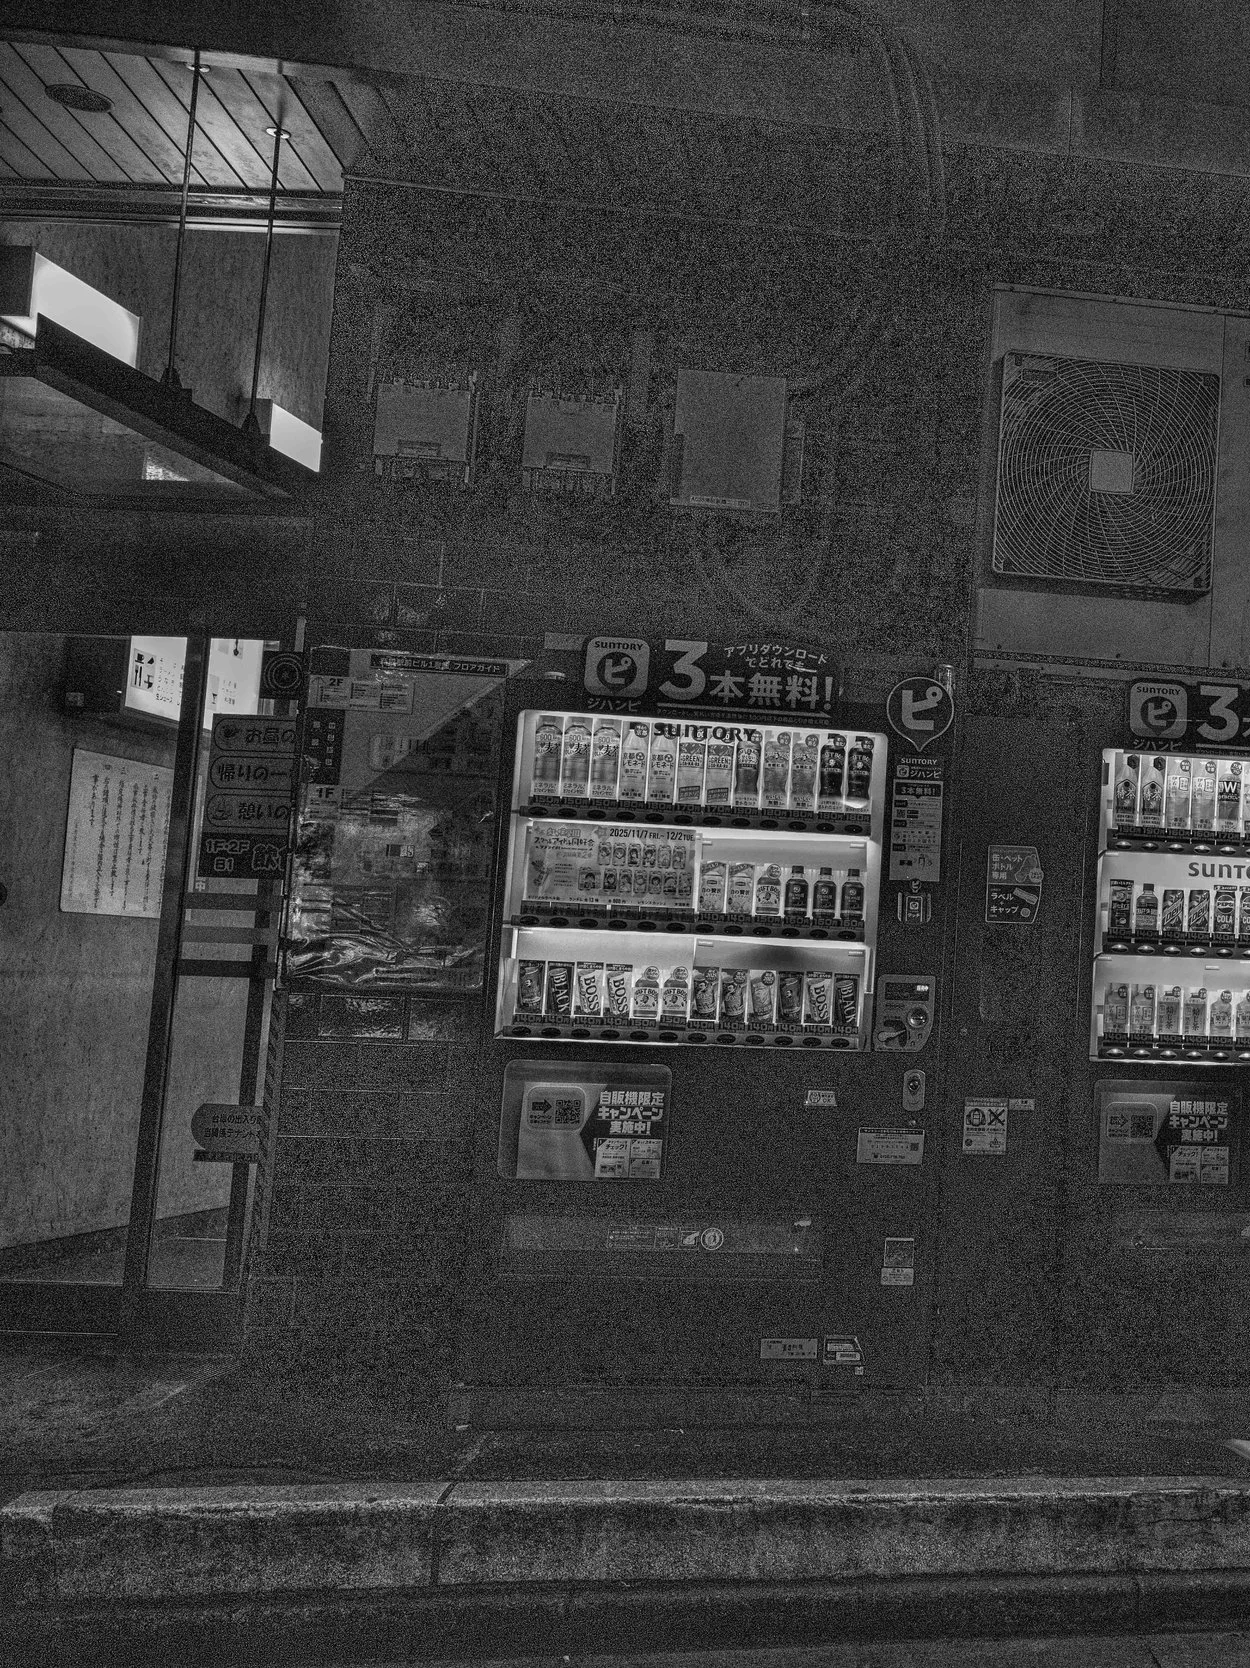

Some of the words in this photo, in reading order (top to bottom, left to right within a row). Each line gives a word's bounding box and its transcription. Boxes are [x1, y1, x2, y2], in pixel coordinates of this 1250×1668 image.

[594, 640, 643, 652] SUNTORY
[329, 678, 344, 687] 2F
[1136, 686, 1181, 696] SUNTORY
[588, 699, 642, 712] ジハンピ
[653, 722, 757, 742] SUNTORY
[1133, 739, 1182, 751] ジハンピ
[901, 758, 938, 766] SUNTORY
[609, 828, 648, 839] 2025/11/7
[666, 831, 683, 841] 12/2
[991, 892, 1014, 901] ラベル
[990, 904, 1019, 914] キャップ
[1217, 915, 1234, 924] COLA
[553, 972, 571, 1013] BLACK
[583, 976, 600, 1012] BOSS
[613, 977, 629, 1013] BOSS
[813, 985, 829, 1019] BOSS
[841, 980, 857, 1023] BLACK
[597, 1106, 663, 1120] キャンペーン
